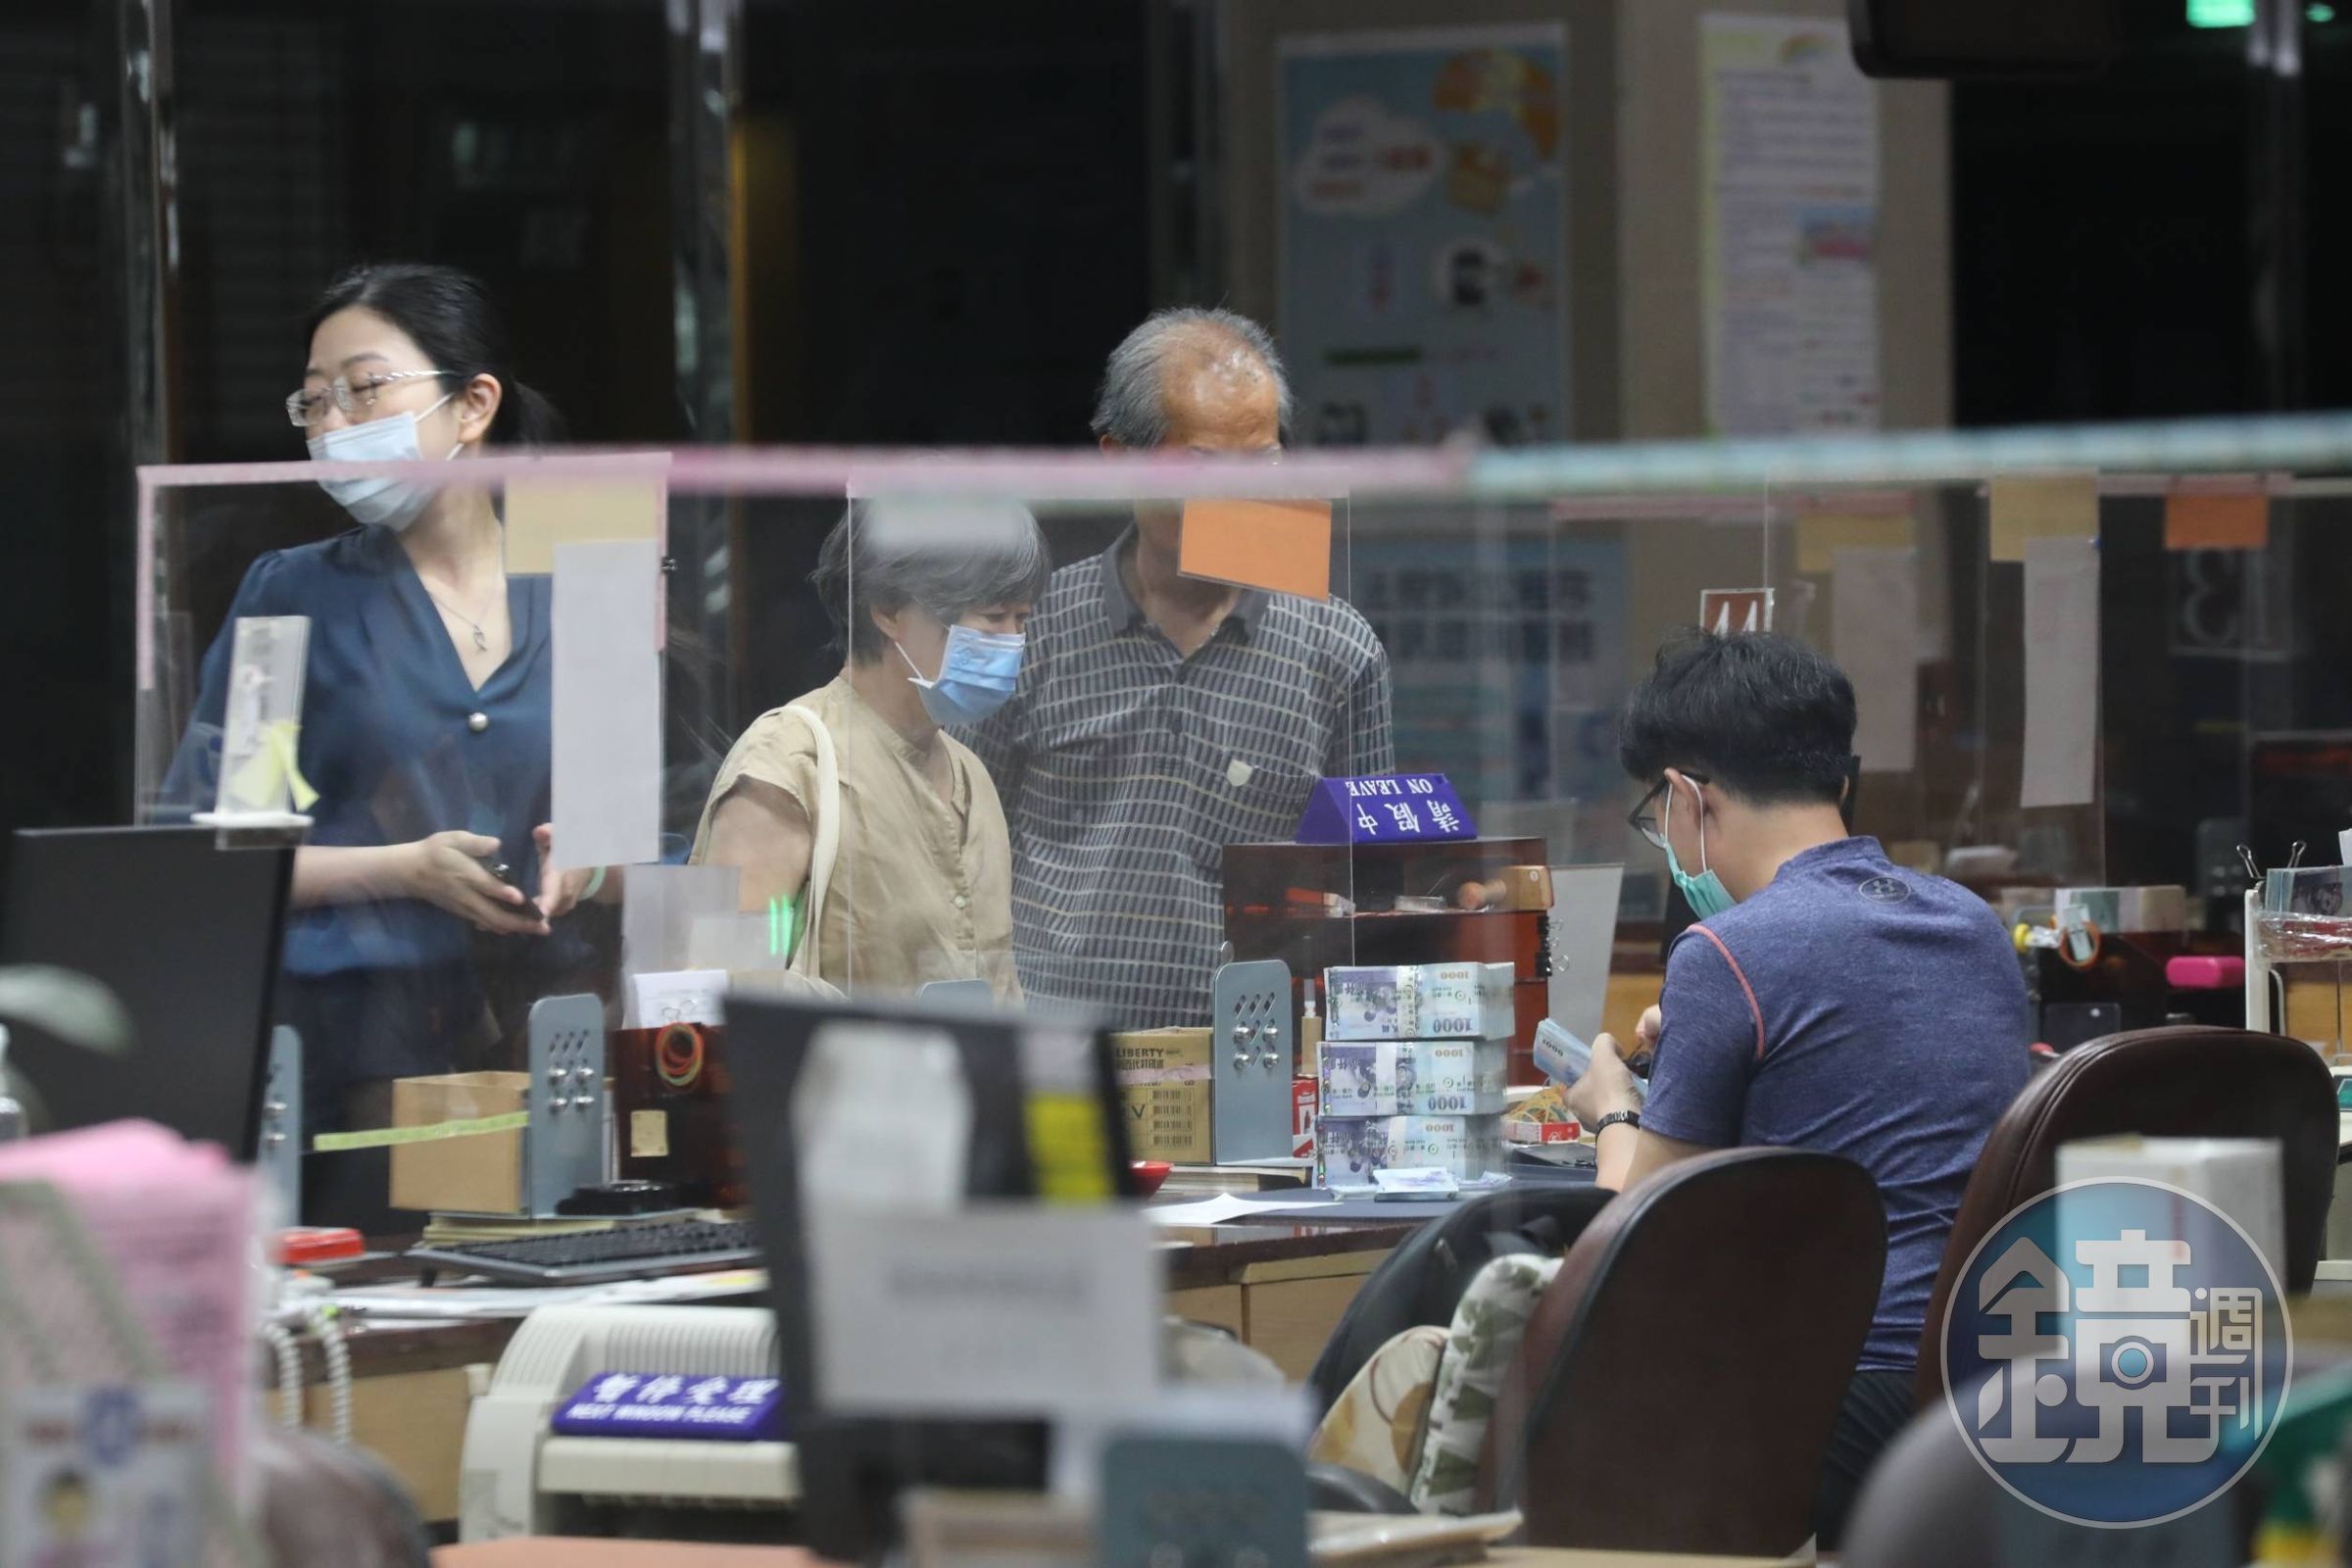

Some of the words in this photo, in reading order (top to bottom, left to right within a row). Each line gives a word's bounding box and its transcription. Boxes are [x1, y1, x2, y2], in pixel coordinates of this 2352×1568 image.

[1346, 779, 1402, 797] LEAVE
[1406, 778, 1434, 795] ON
[1356, 800, 1461, 836] 請假中
[1440, 970, 1469, 981] 1000
[1433, 1018, 1472, 1033] 1000
[1115, 1047, 1164, 1058] LIBERTY
[1435, 1049, 1464, 1058] 1000
[1427, 1097, 1467, 1111] 1000
[1425, 1124, 1454, 1133] 1000
